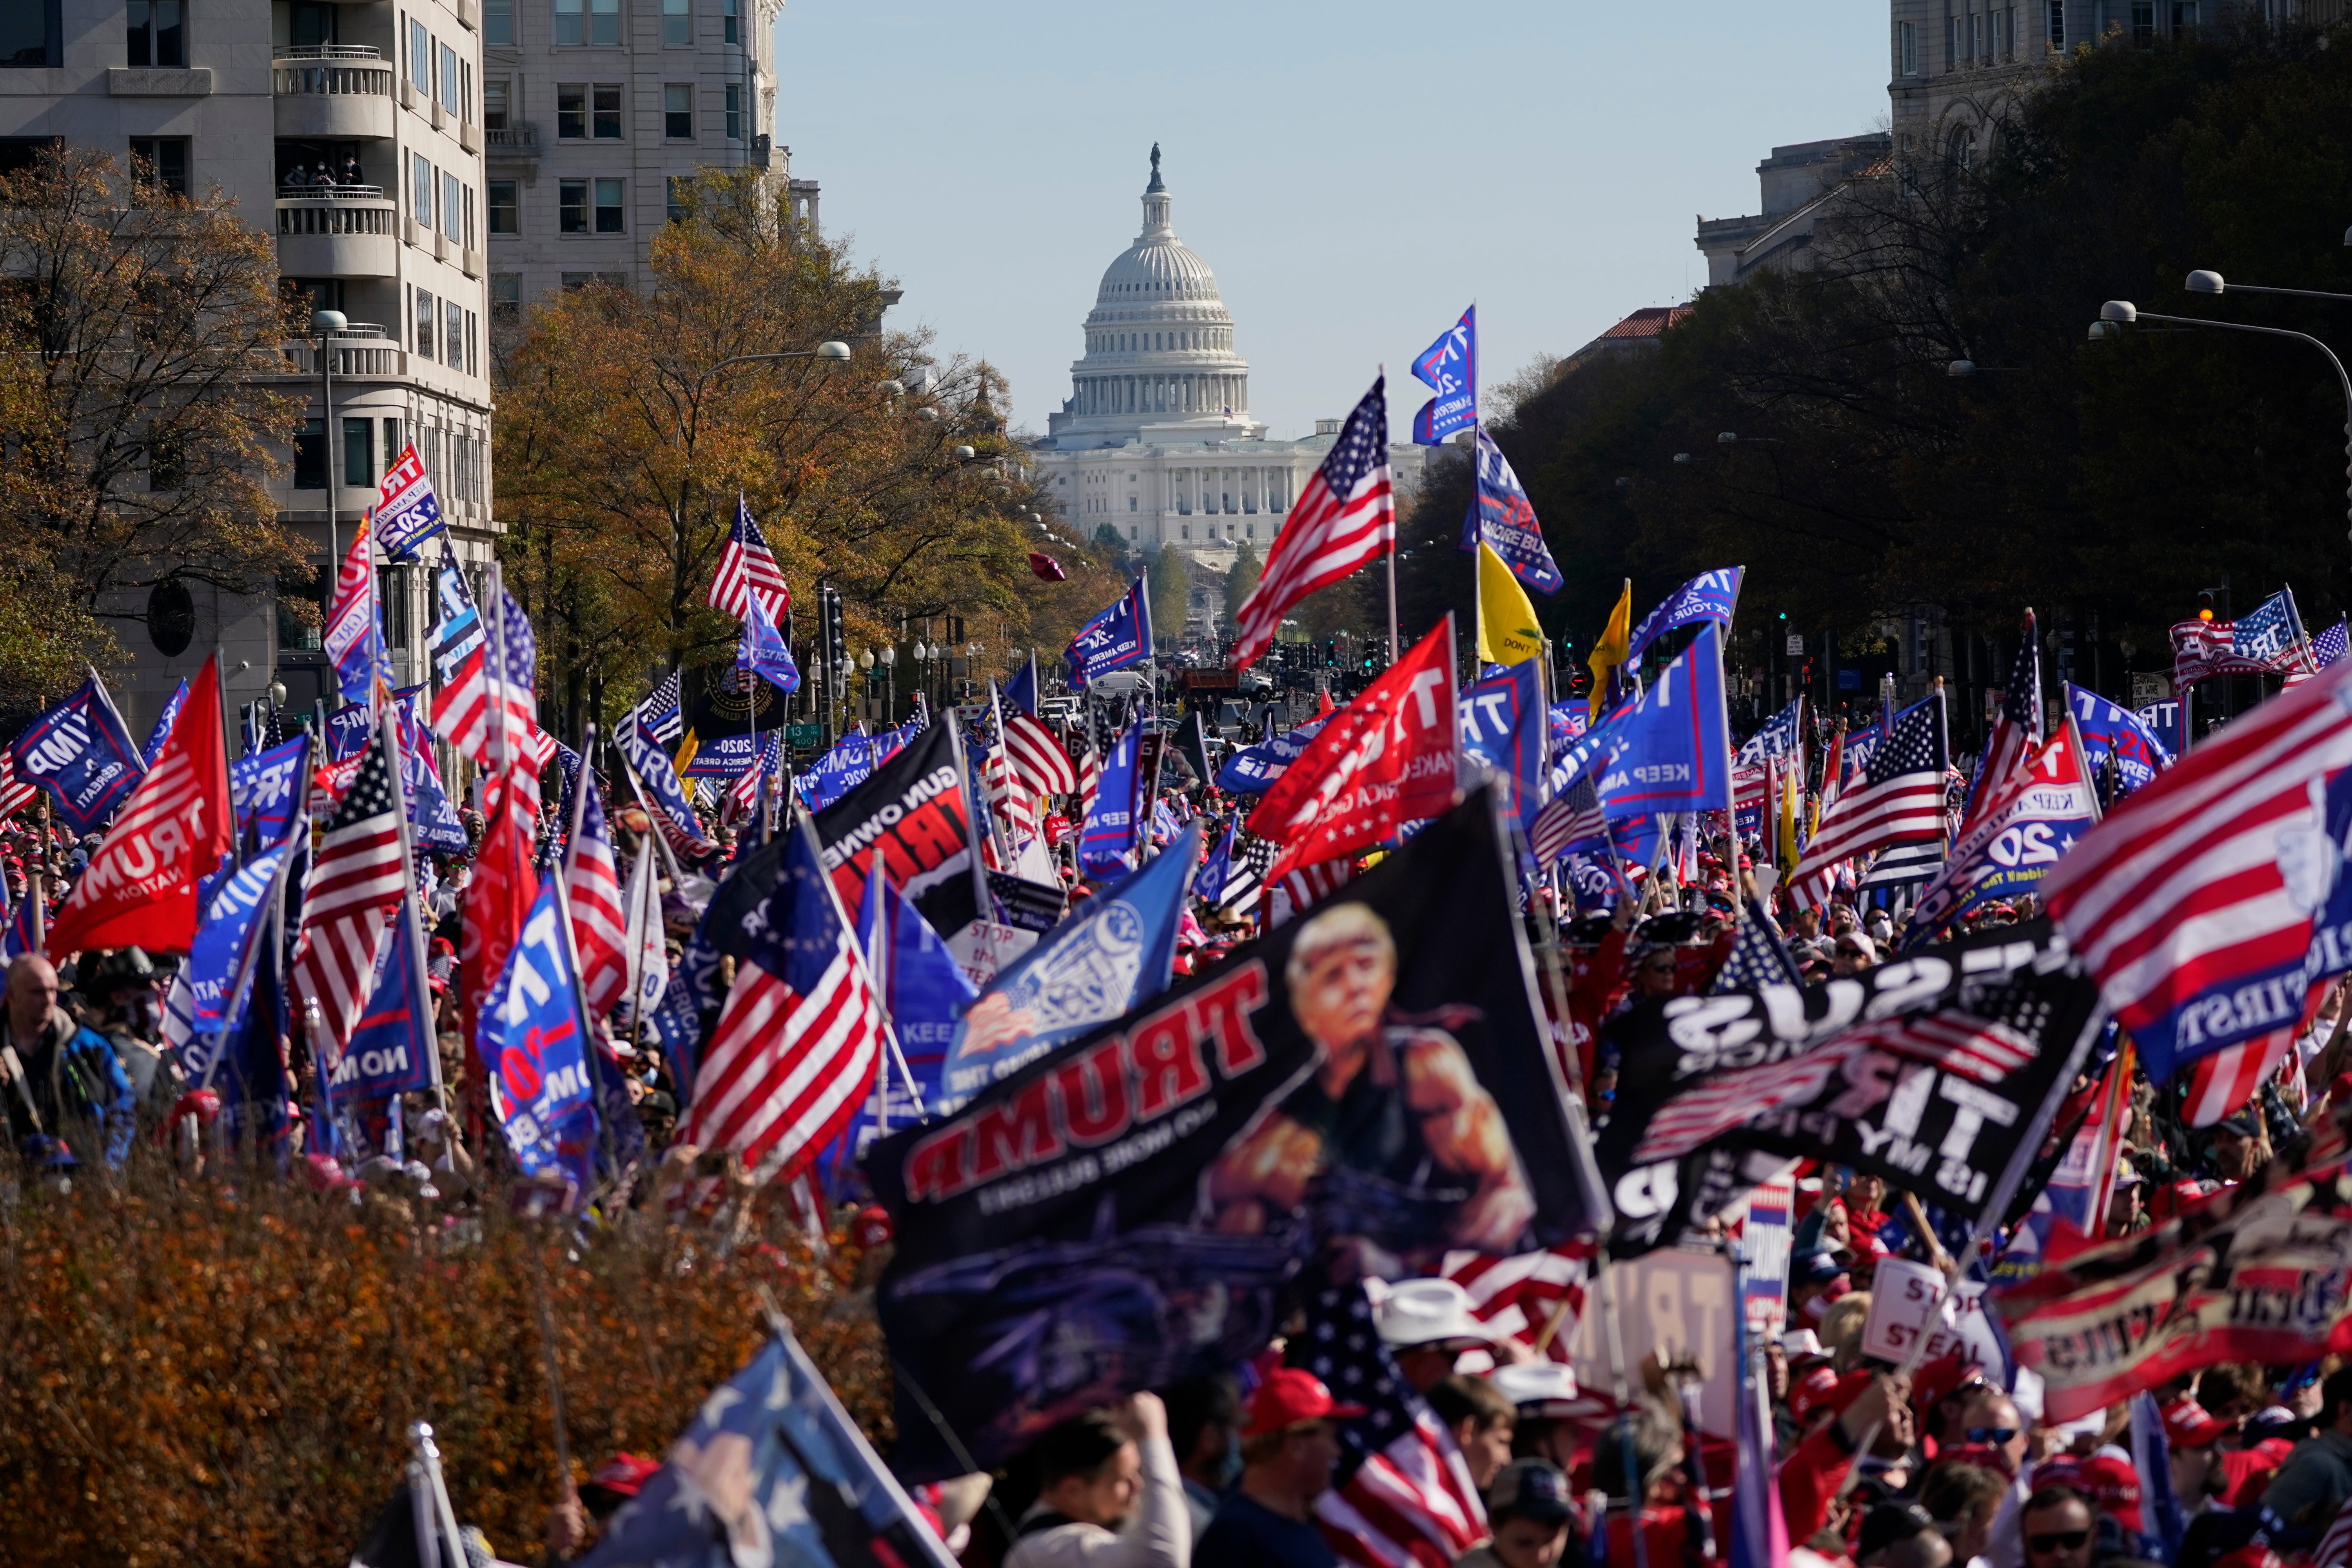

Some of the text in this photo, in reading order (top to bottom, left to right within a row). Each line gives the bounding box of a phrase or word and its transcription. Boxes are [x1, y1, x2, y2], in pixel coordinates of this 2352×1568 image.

[1504, 637, 1531, 654] DONT
[710, 704, 740, 721] DONALD
[754, 693, 774, 718] TRUMP
[301, 715, 312, 723] 13
[790, 726, 802, 737] 13
[970, 922, 1014, 945] STOP
[902, 1022, 953, 1044] KEE
[1907, 1276, 1981, 1313] STOP
[1885, 1321, 1986, 1368] STEAL
